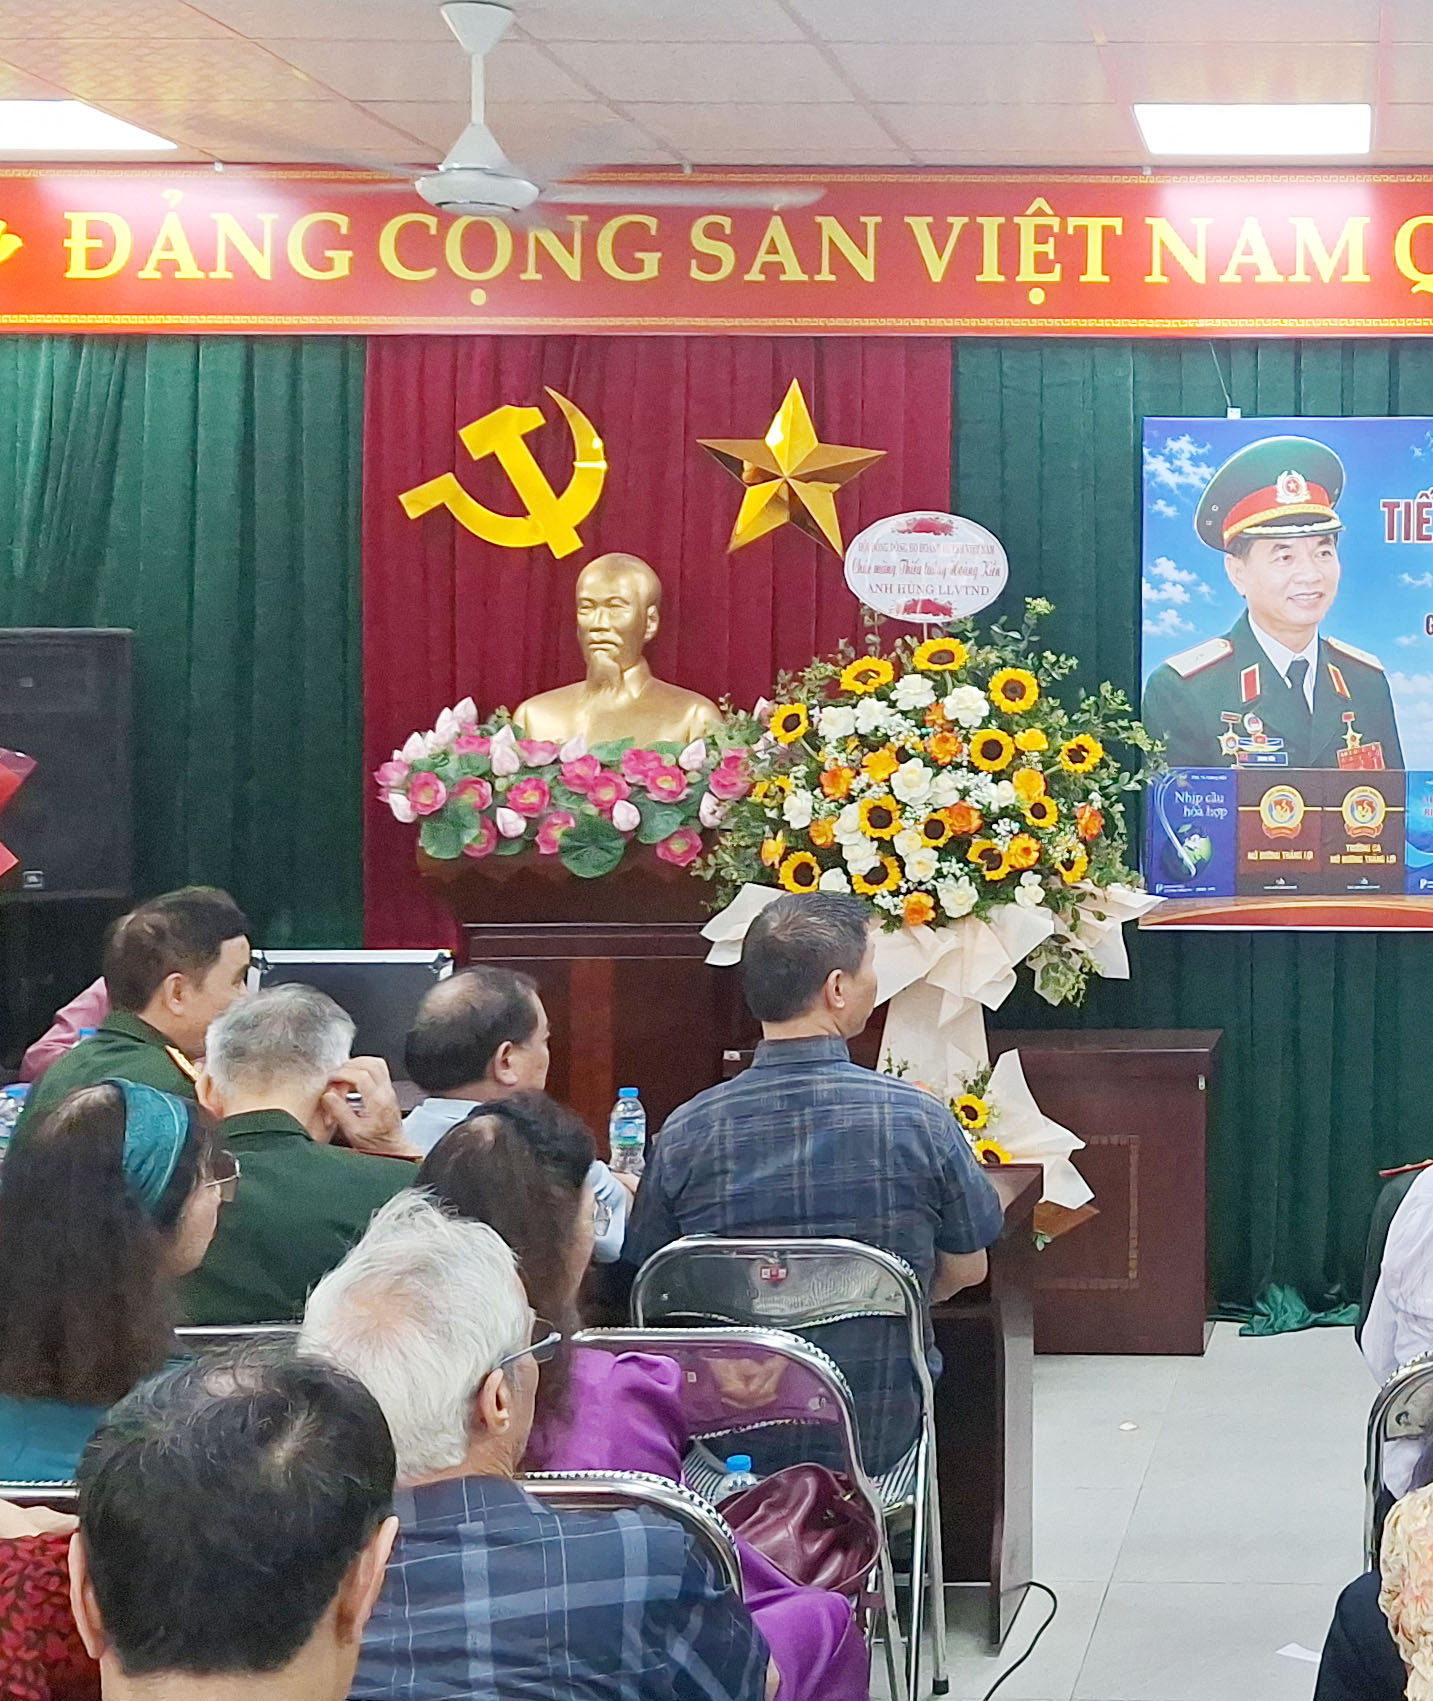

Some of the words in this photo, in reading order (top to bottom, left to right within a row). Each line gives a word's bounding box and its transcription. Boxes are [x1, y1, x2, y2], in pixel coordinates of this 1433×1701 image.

[64, 189, 353, 281] ĐẢNG
[904, 197, 1122, 305] VIỆT
[1144, 215, 1372, 284] NAM
[939, 585, 990, 596] LLVTND
[1174, 791, 1203, 807] Nhịp
